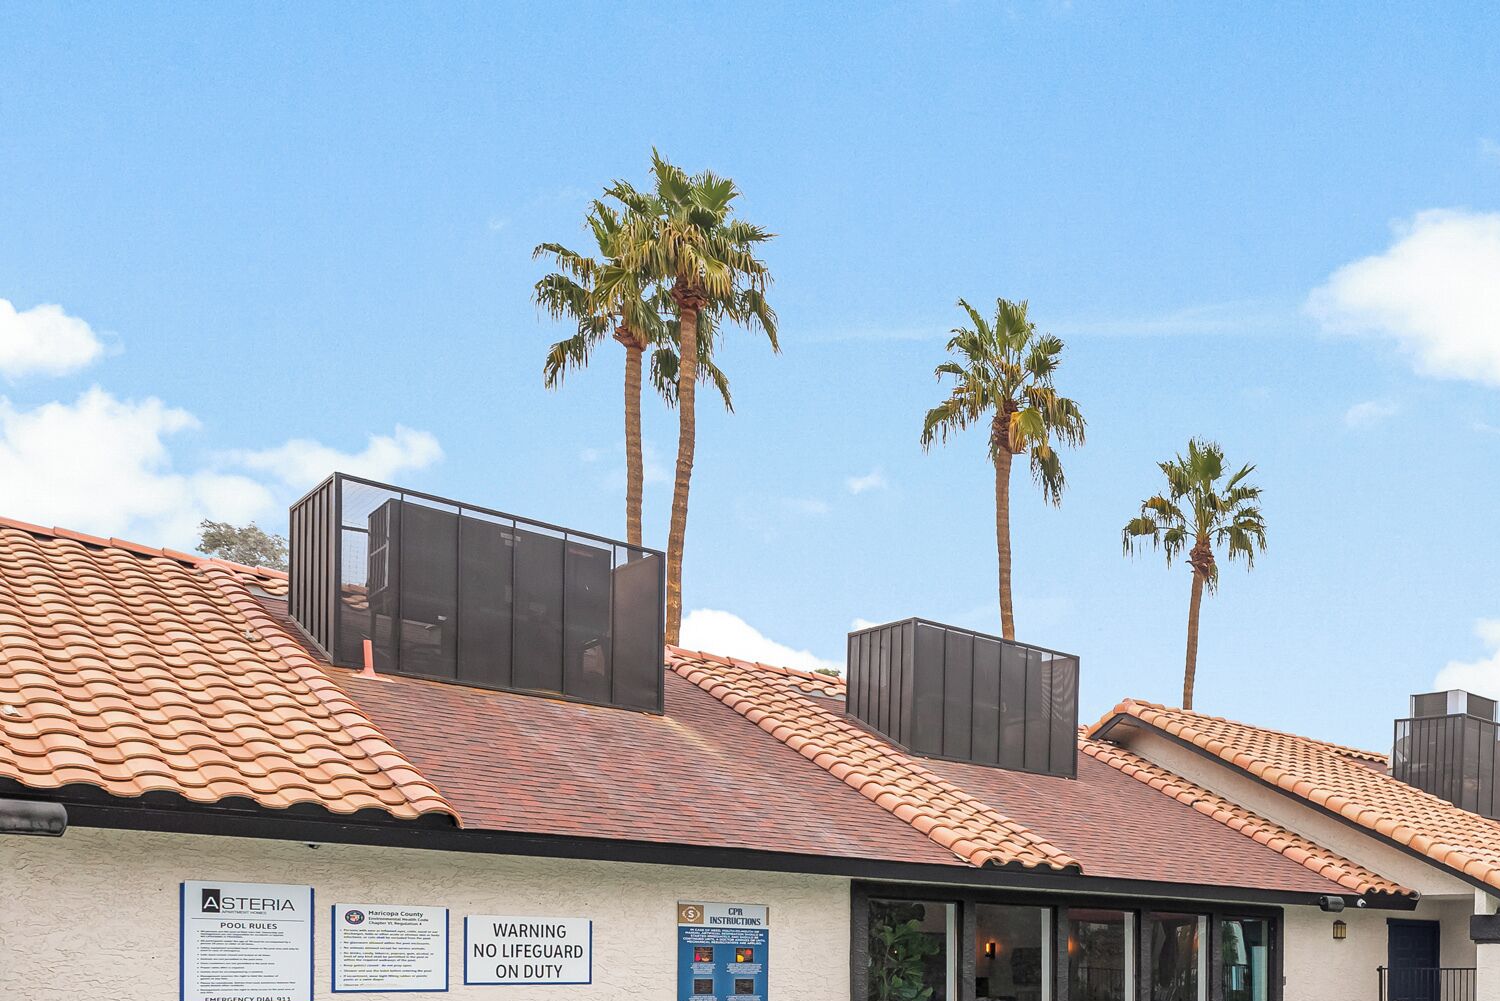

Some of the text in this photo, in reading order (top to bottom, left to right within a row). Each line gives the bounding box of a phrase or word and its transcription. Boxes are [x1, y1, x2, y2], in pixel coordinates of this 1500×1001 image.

[203, 896, 295, 912] ASTERIA
[728, 907, 743, 916] CPR
[249, 922, 278, 930] RULES
[710, 916, 761, 926] INSTRUCTIONS
[493, 922, 567, 939] WARNING
[473, 943, 584, 959] NO LIFEGUARD
[495, 964, 563, 979] ON DUTY
